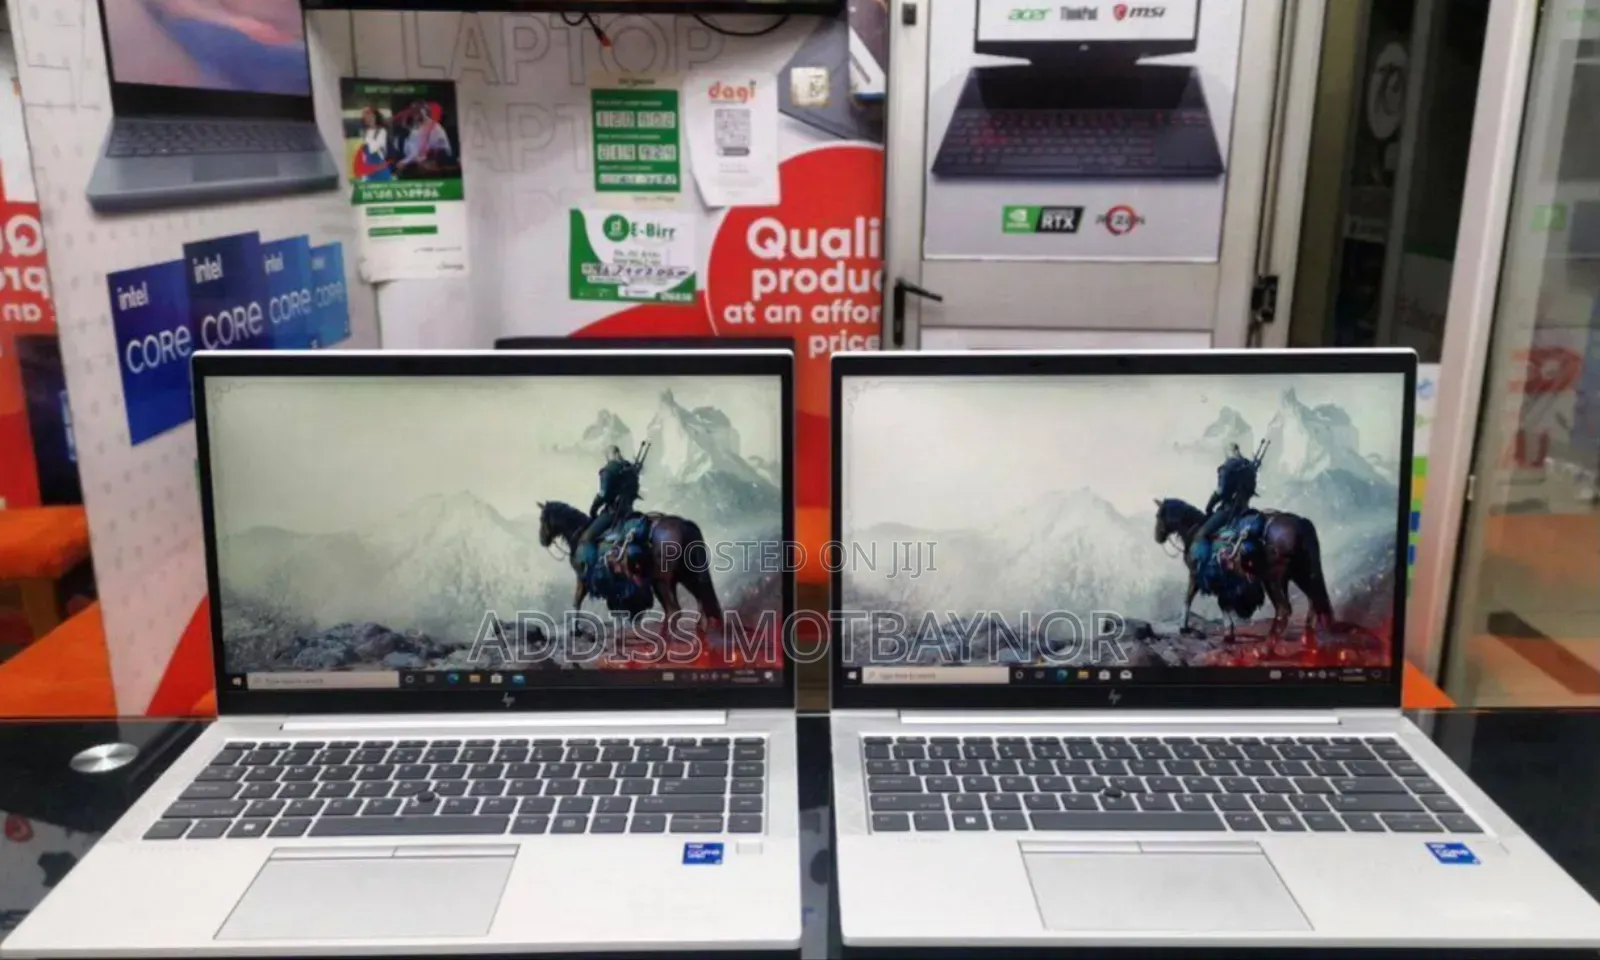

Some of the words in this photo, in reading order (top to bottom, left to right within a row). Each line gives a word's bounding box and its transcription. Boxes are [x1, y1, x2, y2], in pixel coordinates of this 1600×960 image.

[1008, 8, 1052, 21] acer
[1129, 7, 1166, 18] msi
[708, 79, 757, 103] dagi
[1041, 215, 1075, 229] RTX
[746, 216, 881, 260] Quali
[192, 253, 224, 284] intel
[117, 281, 149, 311] intel
[723, 302, 756, 324] at
[764, 303, 803, 324] an
